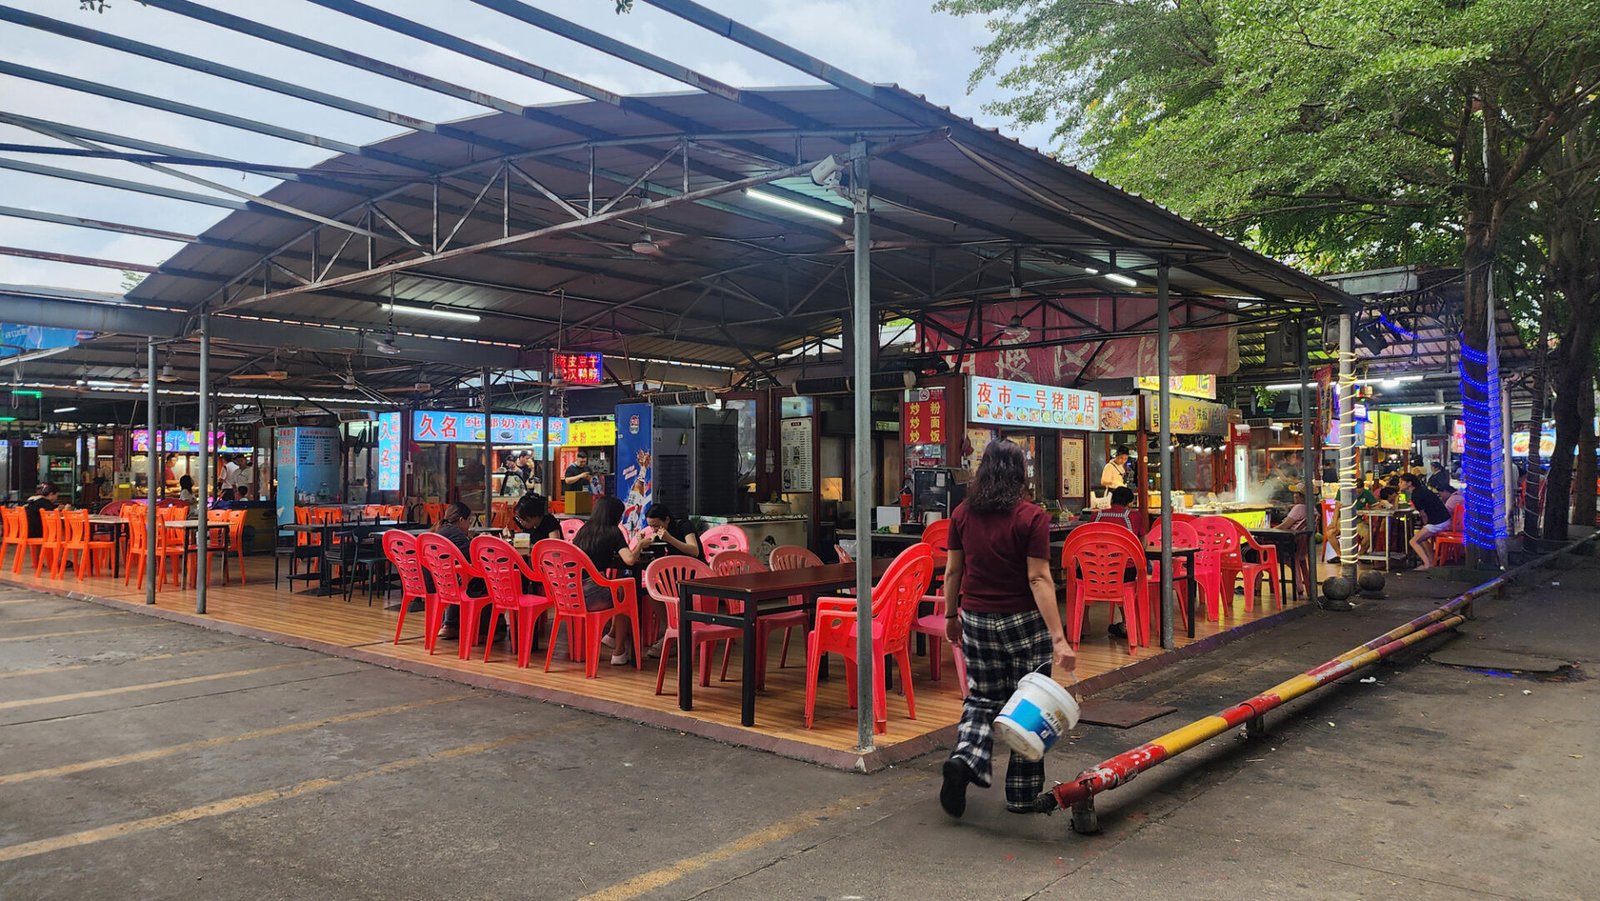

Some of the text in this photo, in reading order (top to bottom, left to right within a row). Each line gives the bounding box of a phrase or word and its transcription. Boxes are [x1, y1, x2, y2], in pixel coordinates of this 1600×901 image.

[977, 382, 1095, 414] 夜市一号猪脚店
[419, 414, 457, 438] 久名
